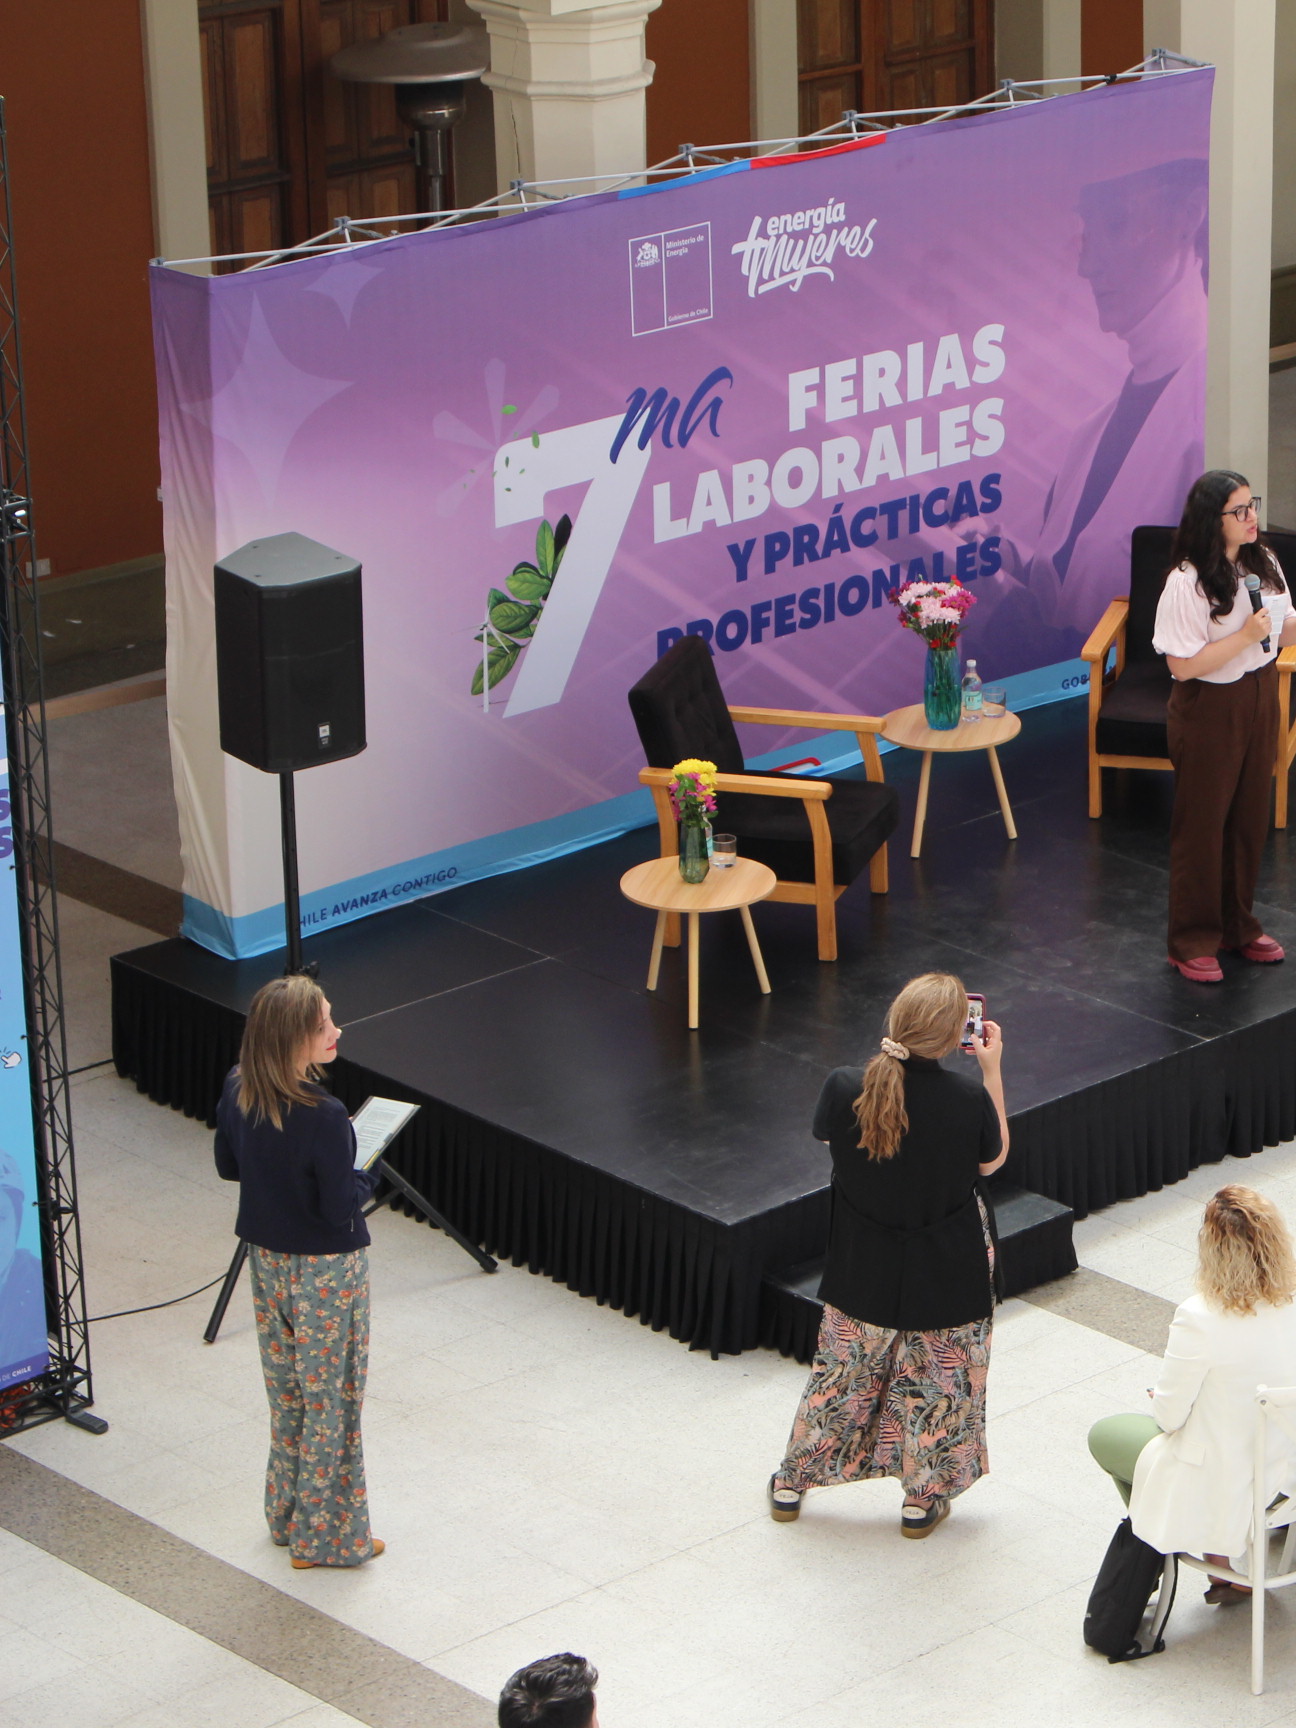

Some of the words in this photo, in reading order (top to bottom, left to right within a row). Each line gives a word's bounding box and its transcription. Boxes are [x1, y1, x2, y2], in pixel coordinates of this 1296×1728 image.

[665, 237, 696, 249] Ministerio
[696, 234, 705, 242] de
[766, 197, 846, 236] energía
[665, 247, 688, 258] Energía
[788, 323, 1006, 432] FERIAS
[653, 397, 1005, 544] LABORALES
[726, 538, 757, 583] Y
[764, 473, 1003, 576] PRÁCTICAS
[494, 407, 652, 719] 7
[1061, 674, 1090, 690] GOB
[300, 907, 328, 928] HILE
[331, 887, 388, 917] AVANZA
[392, 866, 458, 896] CONTIGO
[11, 1365, 32, 1378] CHILE
